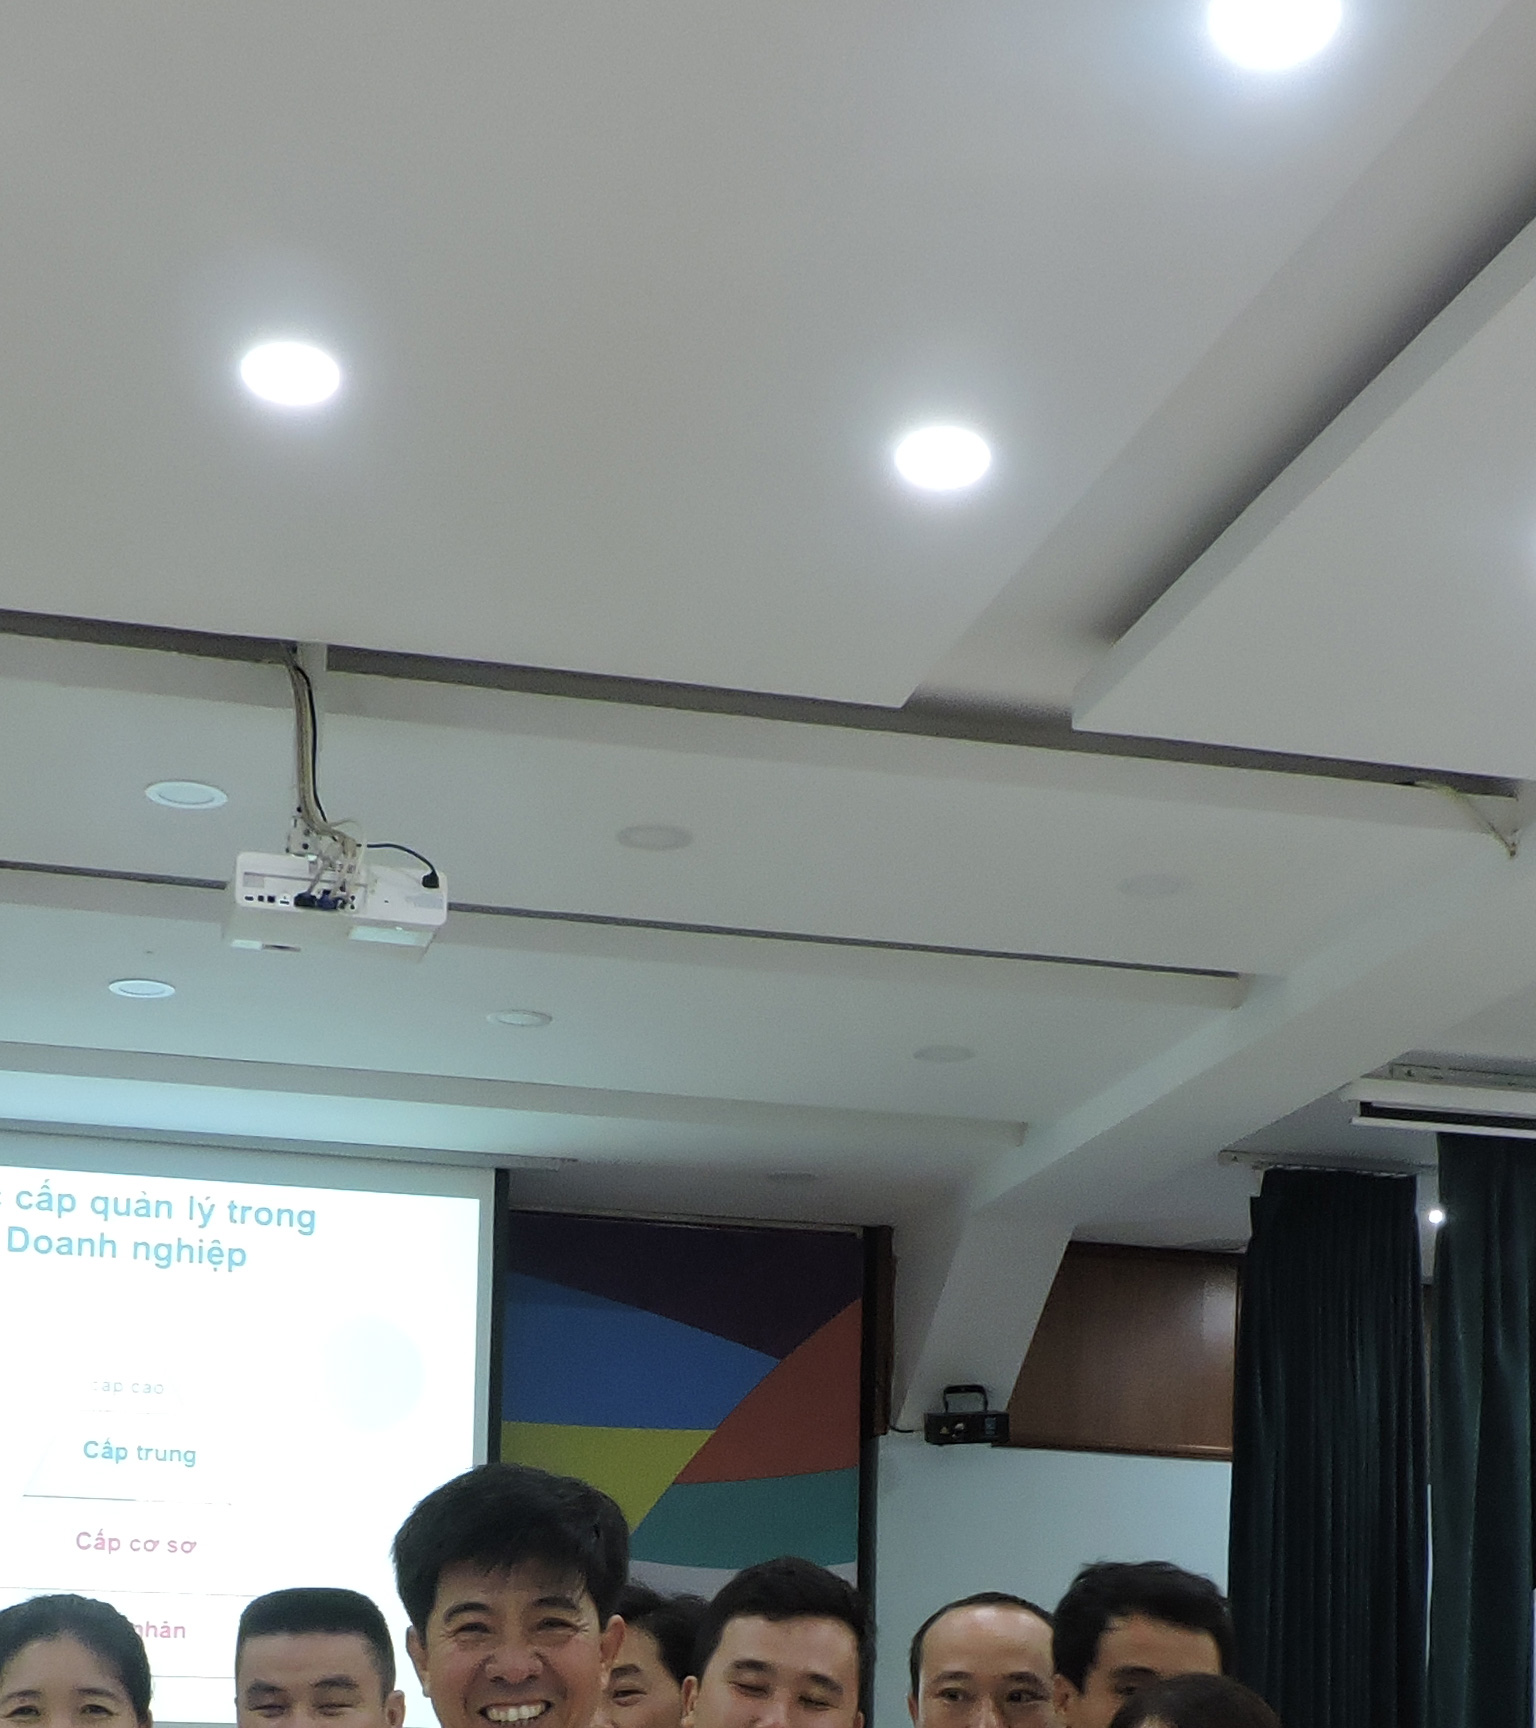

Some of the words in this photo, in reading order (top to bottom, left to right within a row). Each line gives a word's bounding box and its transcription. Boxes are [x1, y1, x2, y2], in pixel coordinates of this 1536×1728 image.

[15, 1179, 76, 1218] cấp
[90, 1191, 173, 1222] quản
[189, 1196, 216, 1229] lý
[227, 1199, 317, 1236] trong
[7, 1226, 117, 1259] Doanh
[133, 1239, 247, 1273] nghiệp
[131, 1381, 164, 1395] cao
[82, 1437, 128, 1464] Cấp
[136, 1445, 197, 1468] trung
[75, 1528, 121, 1555] Cấp
[129, 1538, 160, 1553] cơ
